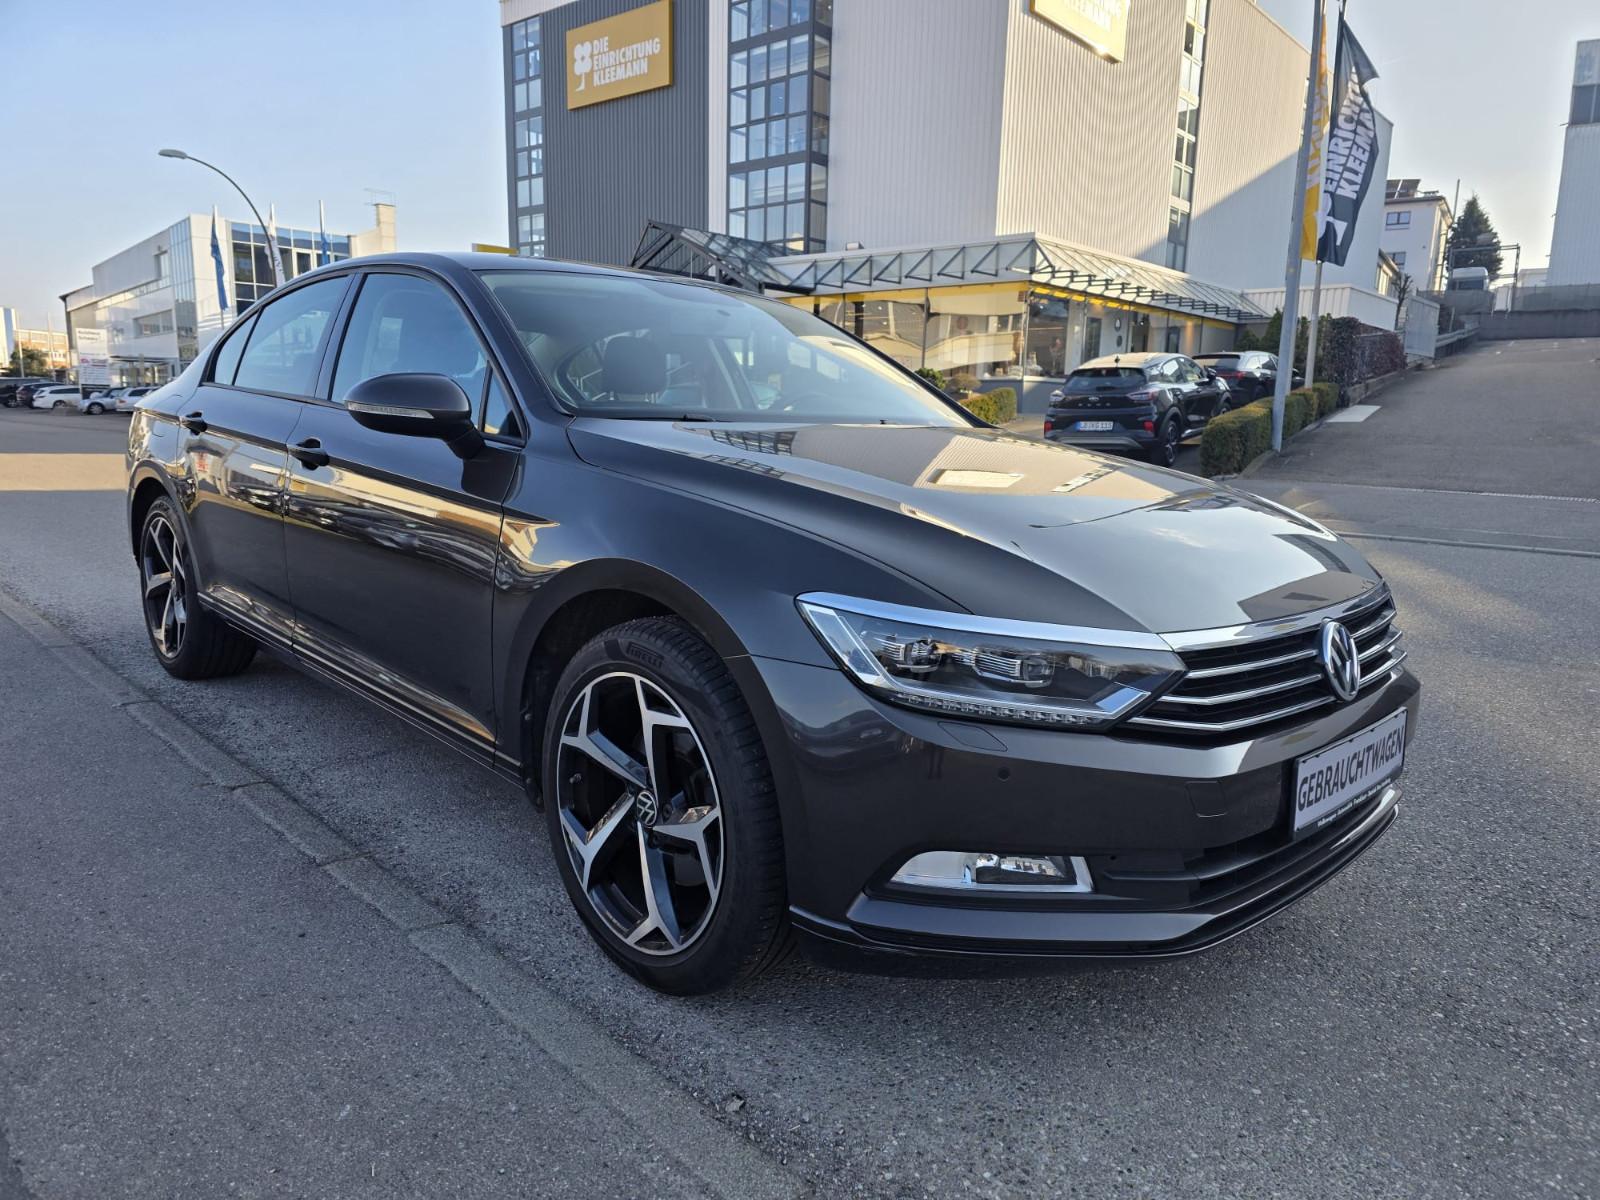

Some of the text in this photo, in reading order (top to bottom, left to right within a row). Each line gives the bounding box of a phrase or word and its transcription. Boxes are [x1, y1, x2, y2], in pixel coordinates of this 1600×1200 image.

[593, 36, 609, 54] DIE
[593, 37, 661, 71] EINRICHTUNG
[593, 57, 648, 87] KLEEMANN
[1298, 726, 1405, 812] GEBRAUCHTWAGEN
